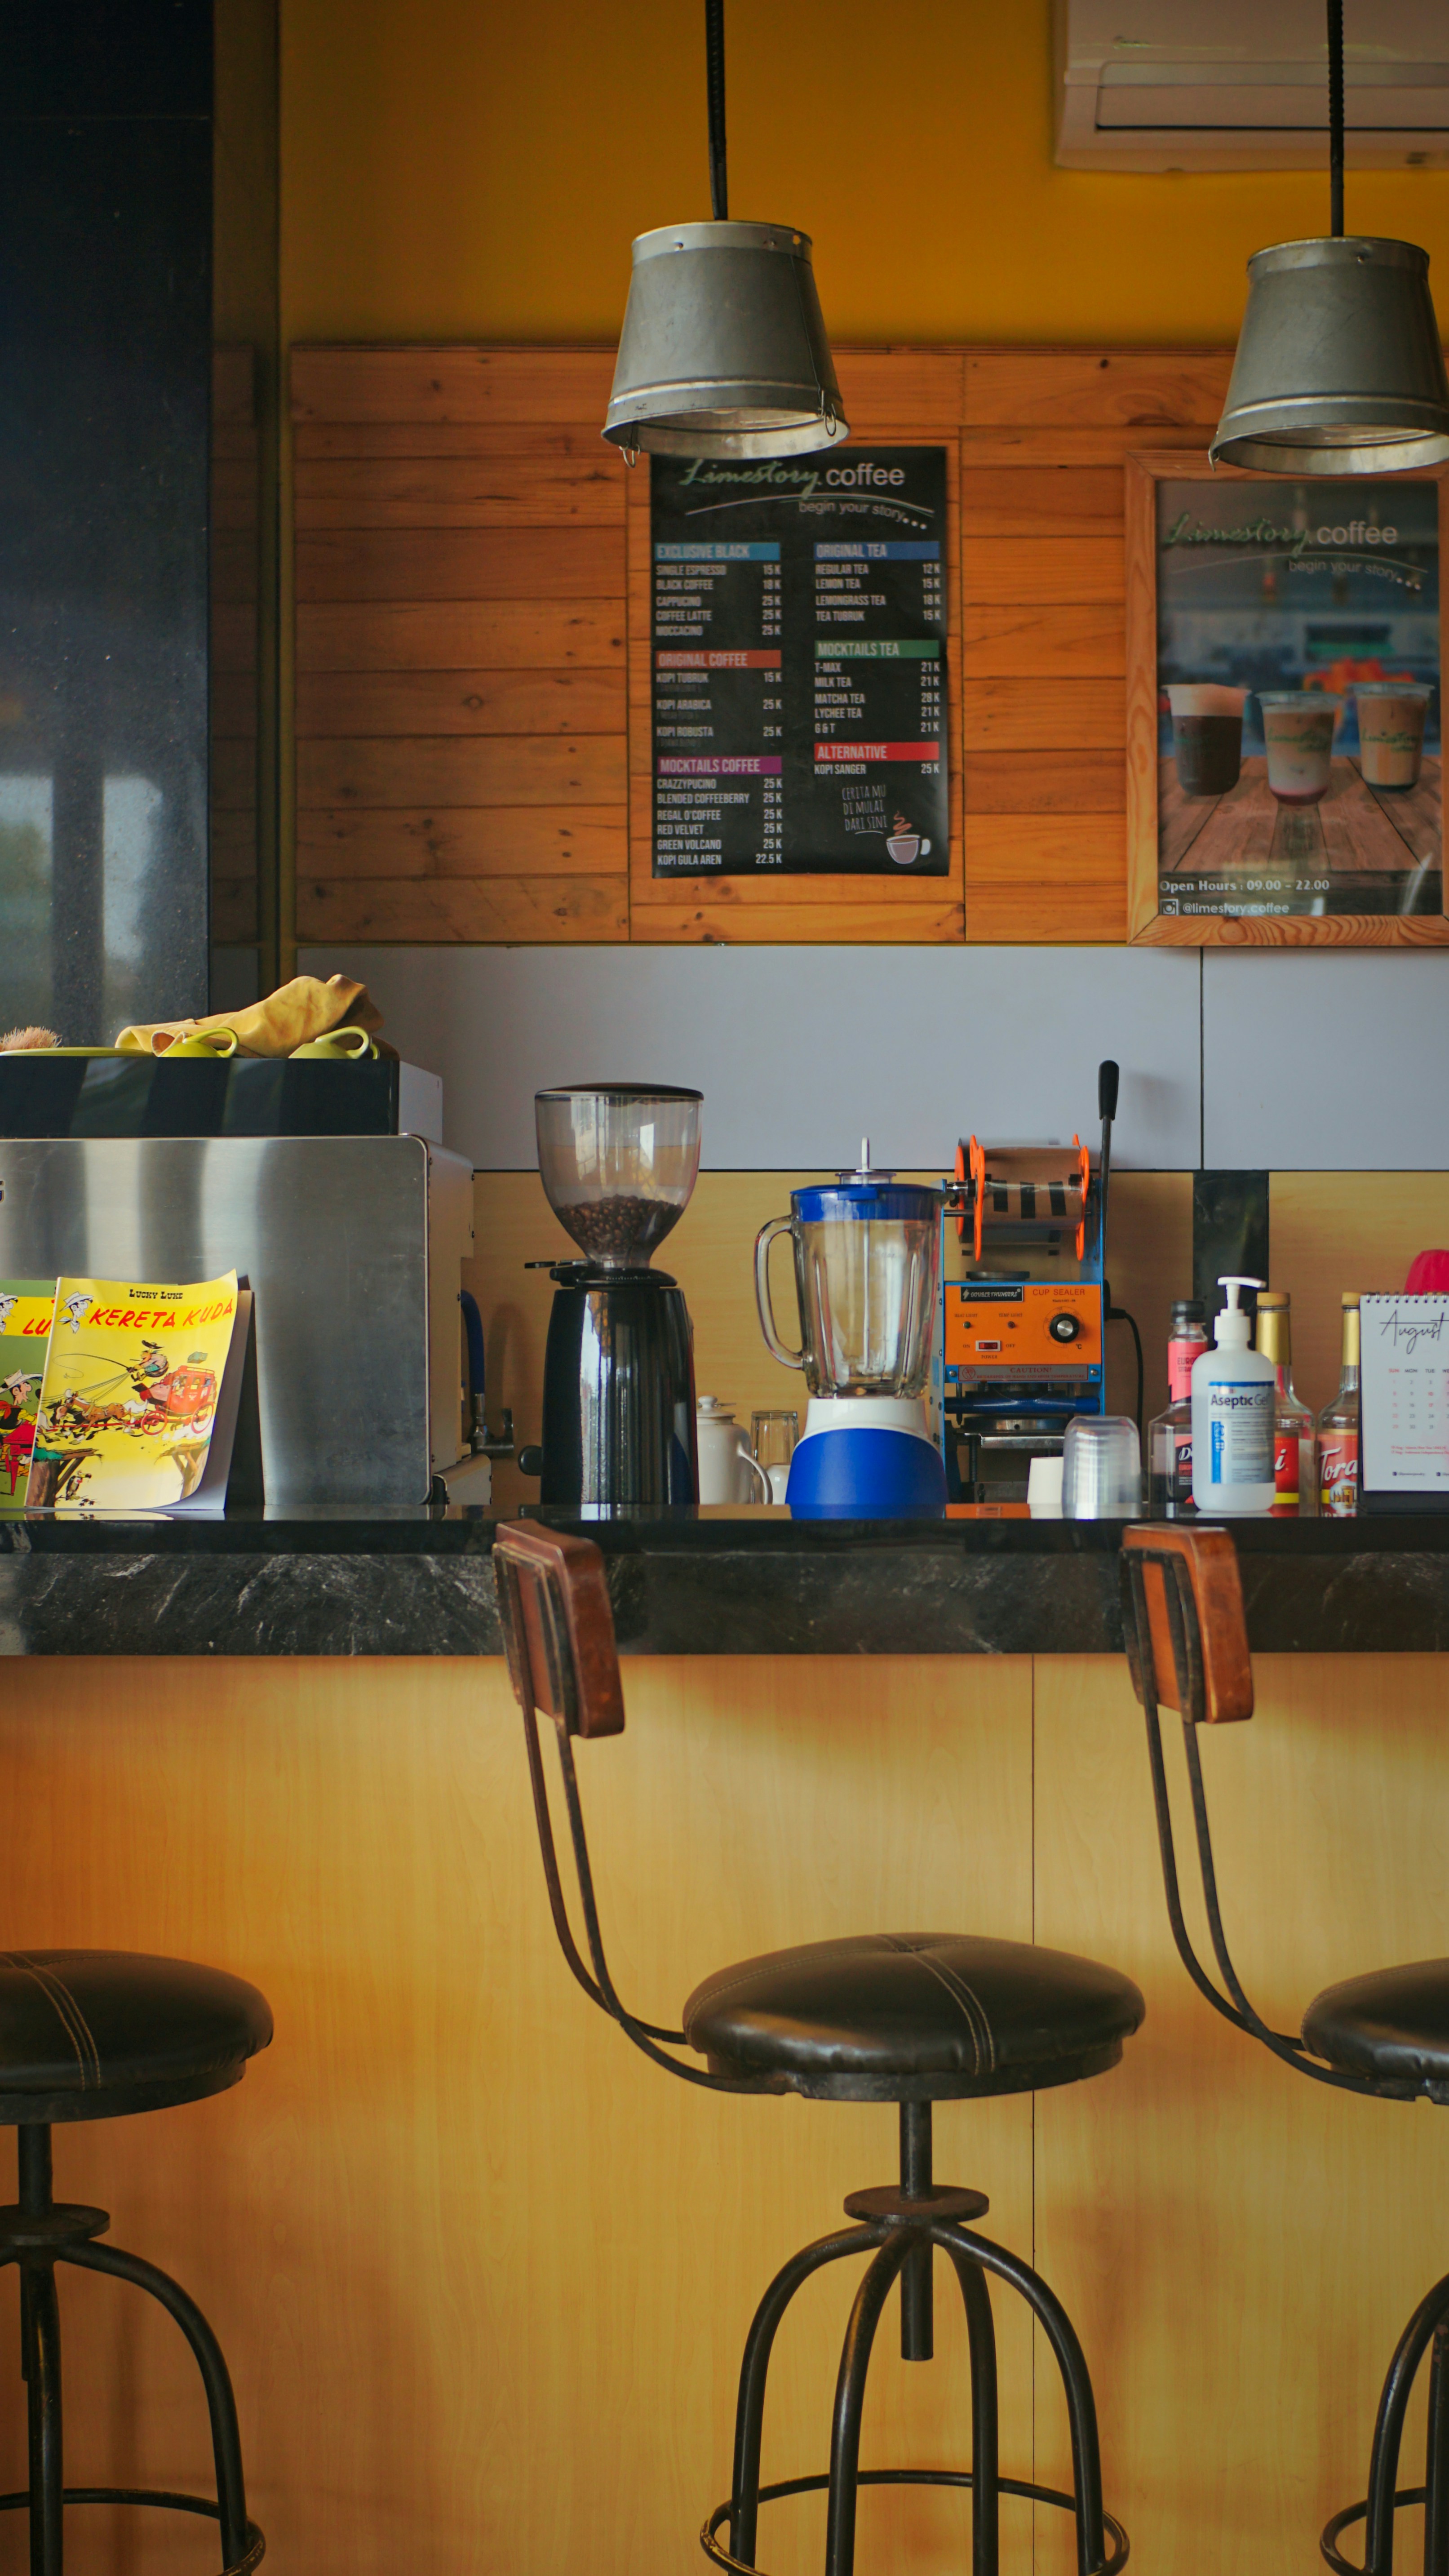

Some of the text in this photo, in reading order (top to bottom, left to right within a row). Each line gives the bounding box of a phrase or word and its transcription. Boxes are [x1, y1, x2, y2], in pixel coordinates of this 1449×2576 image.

[825, 463, 905, 486] coffee
[798, 501, 835, 515] begin
[839, 502, 869, 515] your
[1316, 520, 1398, 545] coffee
[657, 545, 750, 558] EXCLUSIVE BLACK
[816, 544, 887, 558] ORIGINAL TEA
[656, 565, 781, 575] SINGLE ESPRESSO 15 K
[815, 563, 940, 574] REGULAR TEA 12 K
[1288, 559, 1326, 574] begin
[1330, 561, 1361, 575] your
[656, 579, 781, 590] BLACK COFFEE 18 K
[815, 578, 940, 589] LEMON TEA 15 K
[762, 595, 773, 606] 25
[775, 595, 781, 606] K
[815, 595, 941, 605] LEMONGRASS TEA 18 K
[656, 609, 782, 621] COFFEE LATTE 25 K
[815, 610, 941, 621] TEA TUBRUK 15 K
[762, 625, 773, 635] 25
[775, 625, 781, 635] K
[818, 643, 900, 656] MOCKTAILS TEA
[659, 653, 748, 667] ORIGINAL COFFEE
[815, 662, 940, 673] T-MAX 21 K
[656, 673, 675, 683] KOPI
[764, 672, 774, 682] 15
[775, 672, 782, 682] K
[815, 676, 939, 687] MILK TEA 21 K
[815, 692, 940, 704] MATCHA TEA 28 K
[656, 699, 782, 710] KOPI ARABICA 25 K
[815, 706, 940, 718] LYCHEE TEA 21 K
[656, 727, 782, 737] KOPI ROBUSTA 25 K
[815, 723, 820, 733] G
[829, 723, 835, 733] T
[921, 722, 932, 732] 21
[933, 722, 939, 732] K
[818, 746, 887, 759] ALTERNATIVE
[660, 759, 760, 773] MOCKTAILS COFFEE
[814, 763, 939, 774] KOPI SANGER 25 K
[657, 778, 782, 789] CRAZZYPUCINO 25 K
[657, 793, 782, 804] BLENDED COFFEEBERRY 25 K
[842, 785, 886, 800] CERITA MU
[843, 800, 884, 815] DI MULAI
[657, 809, 782, 820] REGAL O'COFFEE 25 K
[657, 823, 782, 835] RED VELVET 25 K
[845, 816, 888, 831] DARI SINI
[657, 839, 782, 850] GREEN VOLCANO 25 K
[657, 854, 782, 865] KOPI GULA AREN 22.5 K
[1160, 879, 1330, 894] Open Hours 09.00 22.00
[1182, 902, 1289, 914] @limestory.coffee
[89, 1298, 233, 1328] KERETA KUDA
[1379, 1310, 1449, 1355] August
[1210, 1394, 1254, 1409] Aseptic
